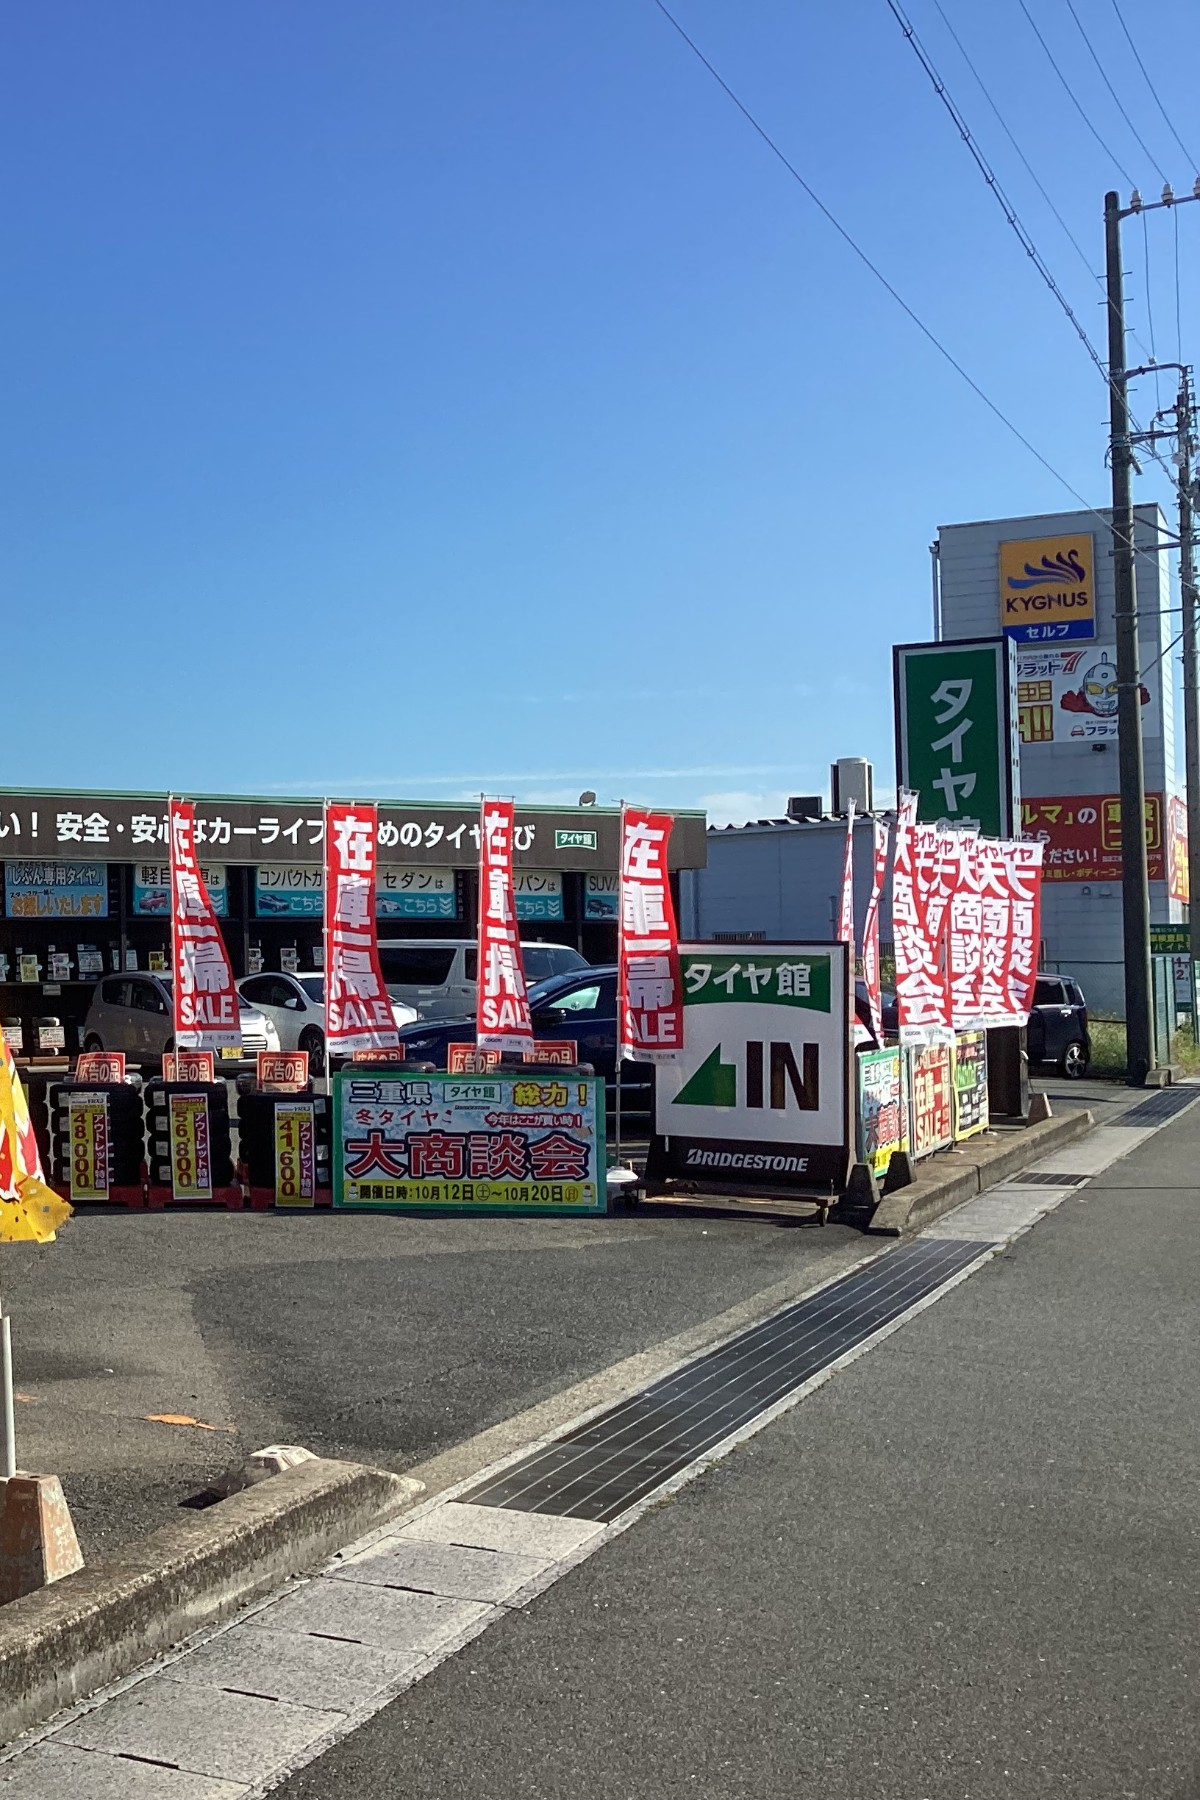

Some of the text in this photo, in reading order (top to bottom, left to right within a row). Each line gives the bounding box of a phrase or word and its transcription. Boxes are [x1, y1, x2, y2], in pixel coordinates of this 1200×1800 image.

[1006, 591, 1088, 614] KYGNUS
[1026, 624, 1070, 640] セルフ
[560, 831, 593, 847] タイヤ館
[141, 865, 221, 886] 軽自車は
[382, 871, 444, 890] セダンは
[403, 898, 438, 914] こちら
[683, 962, 812, 998] タイヤ館
[180, 995, 235, 1025] SALE
[328, 1000, 393, 1032] SALE
[482, 999, 533, 1031] SALE
[261, 1060, 304, 1082] 広告の品
[746, 1040, 820, 1112] IN
[349, 1081, 433, 1106] 三重県
[450, 1086, 496, 1100] タイヤ館
[915, 1110, 942, 1151] SALE
[93, 1114, 106, 1189] アウトレット特価
[194, 1112, 209, 1188] アウトレット特価
[299, 1121, 313, 1198] アウトレット特価
[346, 1130, 591, 1181] 大商談会
[686, 1148, 810, 1173] BRIDGESTONE
